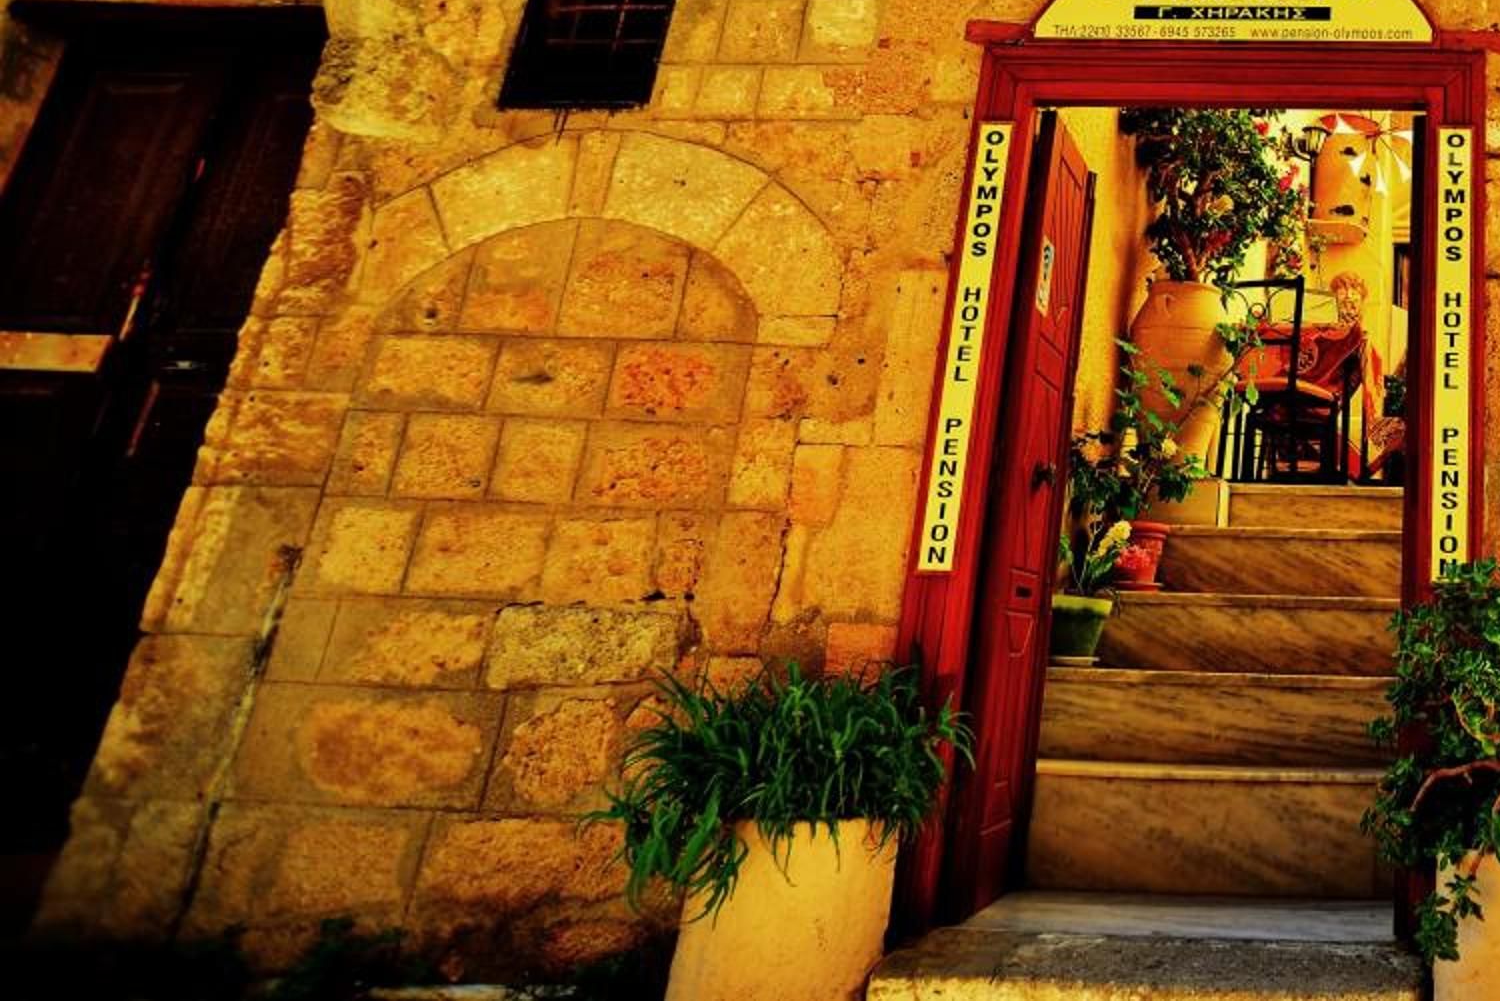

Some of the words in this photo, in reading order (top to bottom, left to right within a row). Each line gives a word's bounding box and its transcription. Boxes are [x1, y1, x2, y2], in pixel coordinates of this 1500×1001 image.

[970, 129, 1005, 257] OLYMPOS
[1443, 133, 1466, 262] OLYMPOS
[953, 286, 981, 383] HOTEL
[1442, 292, 1462, 390] HOTEL
[926, 417, 964, 564] PENSION
